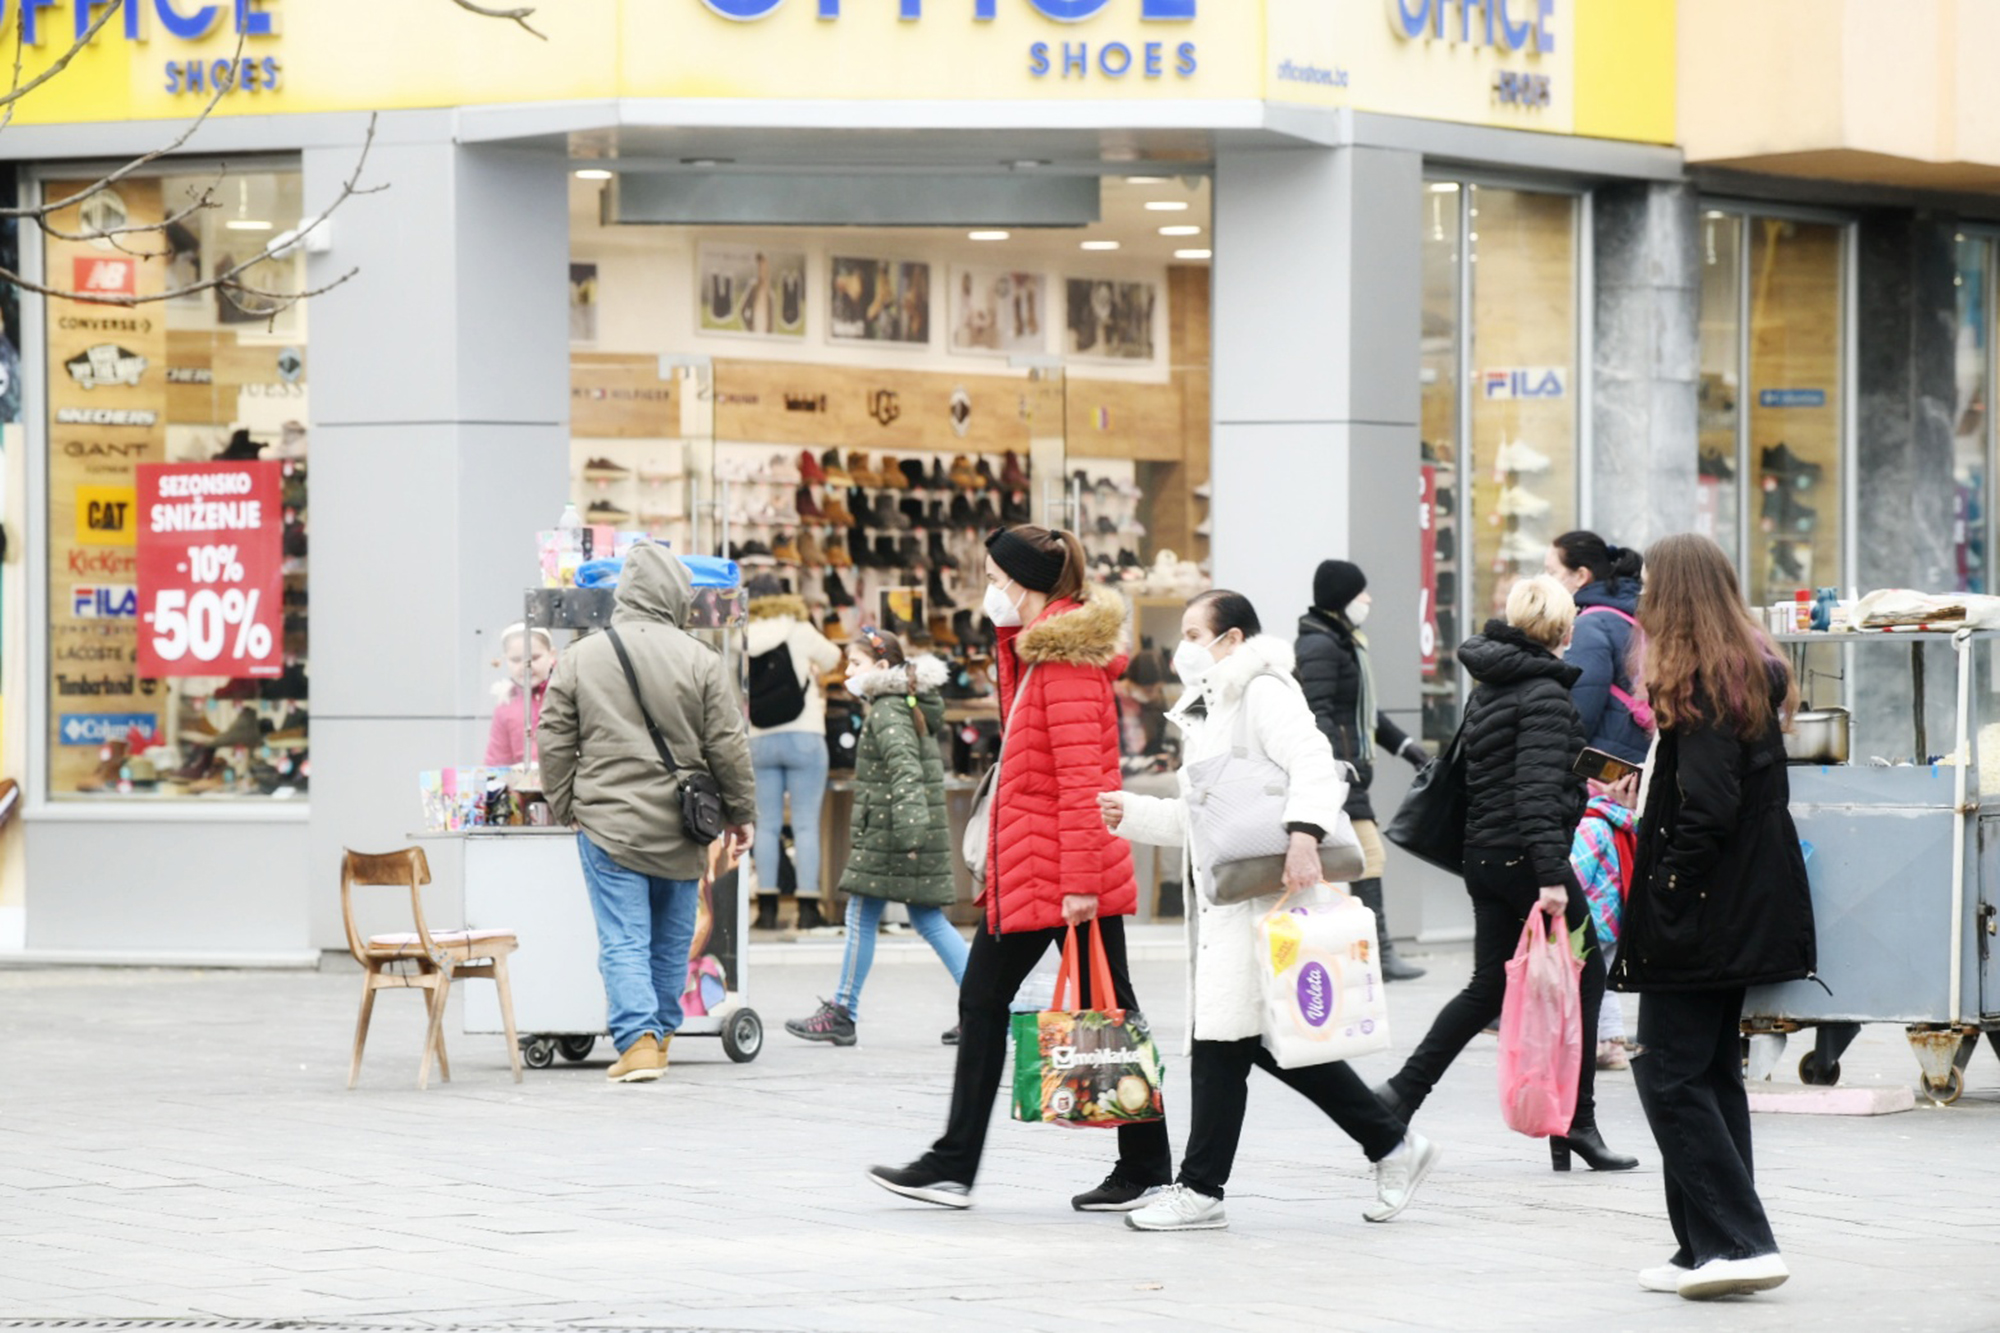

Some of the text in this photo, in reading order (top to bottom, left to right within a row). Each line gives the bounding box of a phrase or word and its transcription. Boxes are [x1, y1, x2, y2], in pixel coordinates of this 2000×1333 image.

[165, 56, 278, 94] SHOES
[1029, 41, 1197, 77] SHOES
[1487, 371, 1563, 398] FILA
[159, 472, 252, 497] SEZONSKO
[88, 500, 129, 530] CAT
[151, 495, 261, 532] SNIŽENJE
[176, 544, 245, 583] -10%
[75, 588, 137, 615] FILA
[144, 588, 272, 661] -50%
